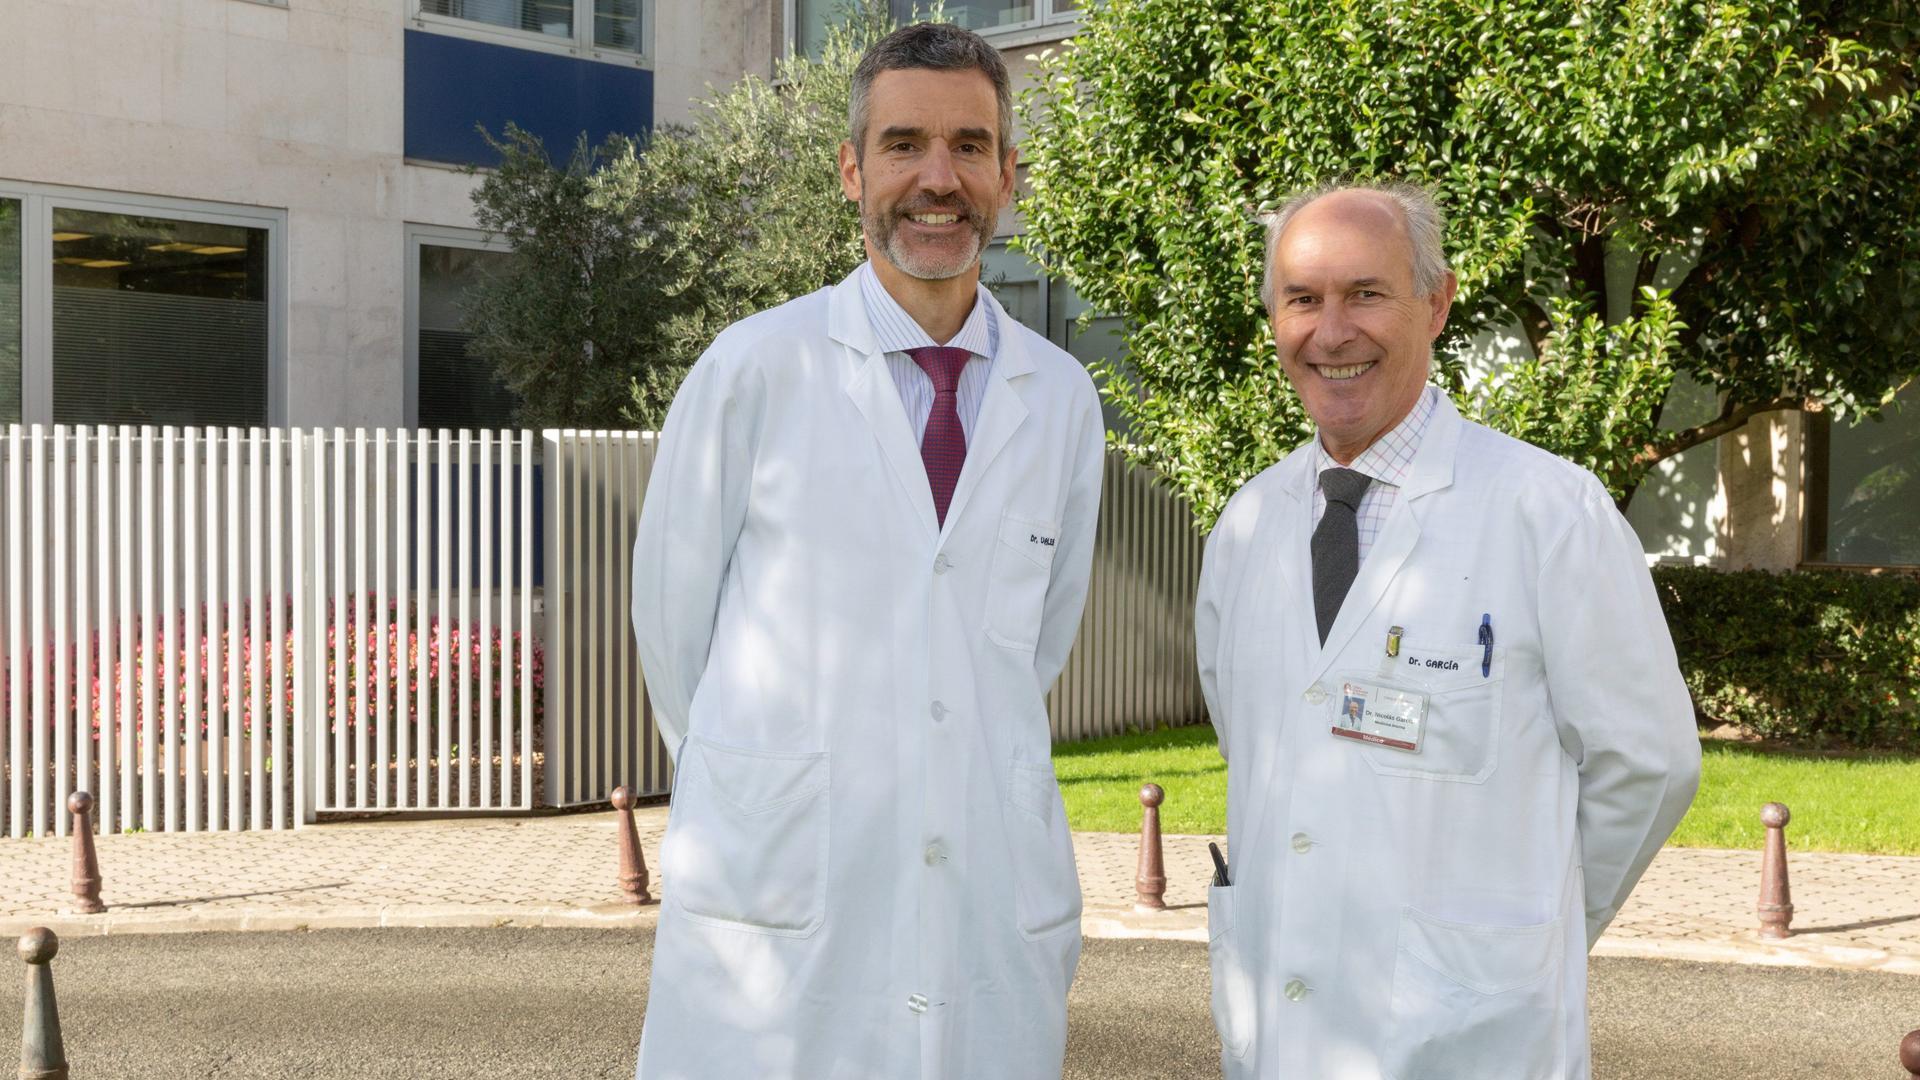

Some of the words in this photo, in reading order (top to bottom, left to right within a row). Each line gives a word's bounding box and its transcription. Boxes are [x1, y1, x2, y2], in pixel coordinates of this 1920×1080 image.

[1030, 534, 1038, 544] Dr.
[1408, 656, 1421, 666] Dr.
[1425, 658, 1459, 671] GARCÍA
